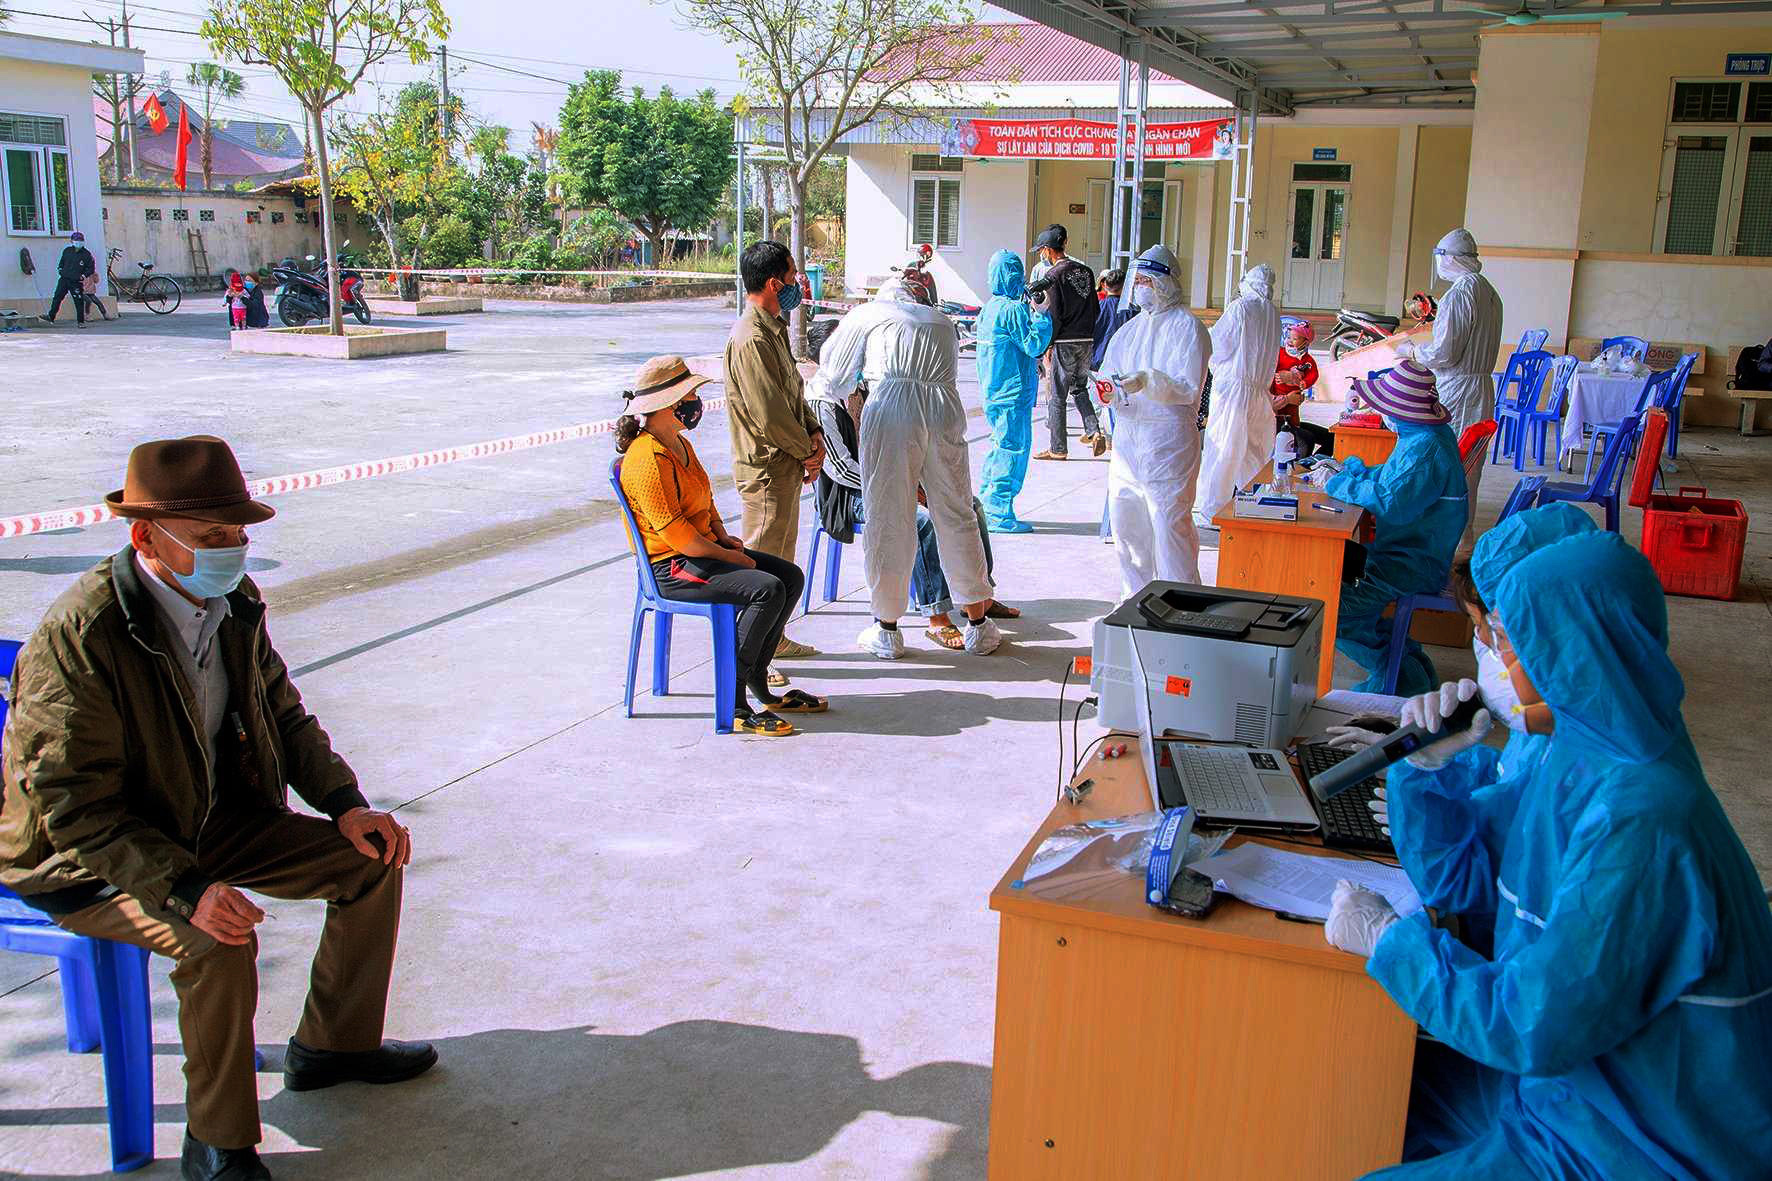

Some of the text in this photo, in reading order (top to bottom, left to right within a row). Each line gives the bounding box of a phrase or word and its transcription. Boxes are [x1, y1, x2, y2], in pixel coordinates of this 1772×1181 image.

[989, 125, 1015, 137] TOÀN
[1017, 124, 1038, 137] DÂN
[1039, 124, 1061, 138] TÍCH
[1063, 125, 1082, 140] CỰC
[1085, 127, 1118, 139] CHUNG
[996, 140, 1007, 156] SỰ
[1023, 142, 1037, 154] LAN
[1039, 138, 1053, 155] CỦA
[1054, 142, 1071, 157] DỊCH
[1072, 142, 1094, 155] COVID
[1101, 143, 1110, 155] 19
[1155, 140, 1174, 156] HÌNH
[1176, 140, 1191, 156] MỚI
